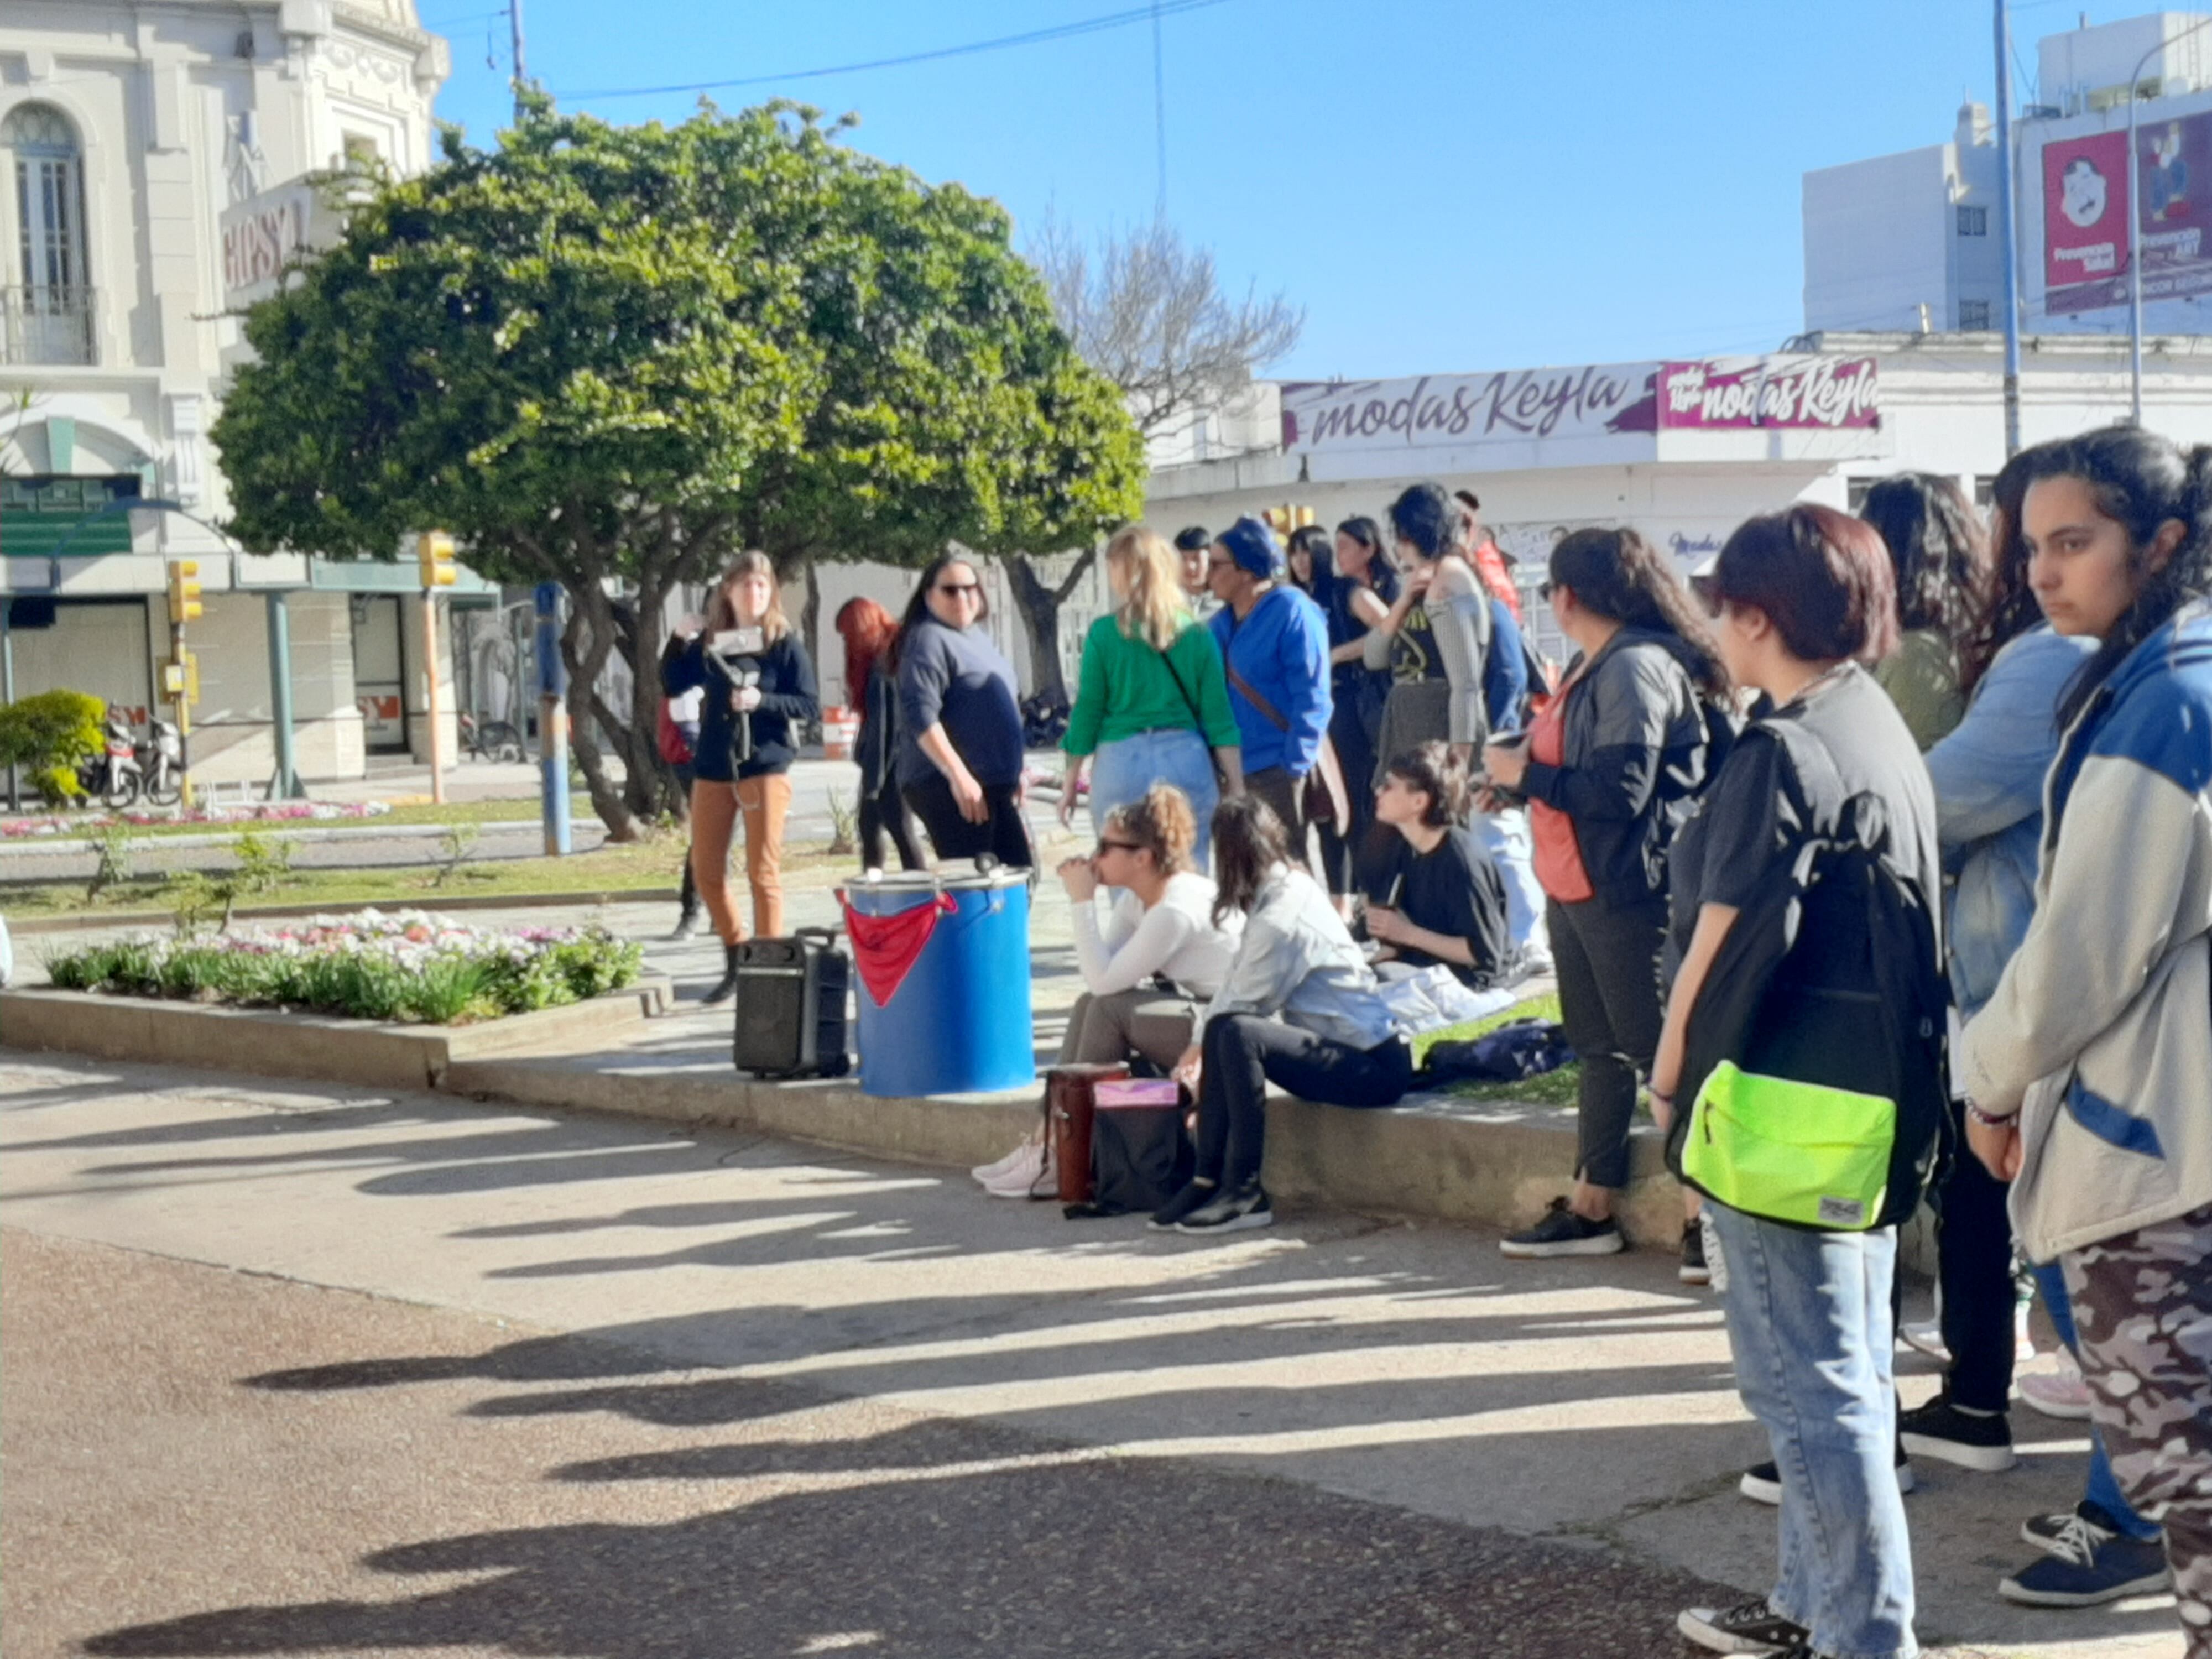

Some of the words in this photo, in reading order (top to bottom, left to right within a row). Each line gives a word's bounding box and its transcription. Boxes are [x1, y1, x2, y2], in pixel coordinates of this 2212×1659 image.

[1312, 376, 1482, 445] modas
[1484, 365, 1630, 437] Keyla
[1797, 361, 1879, 426] Keyla
